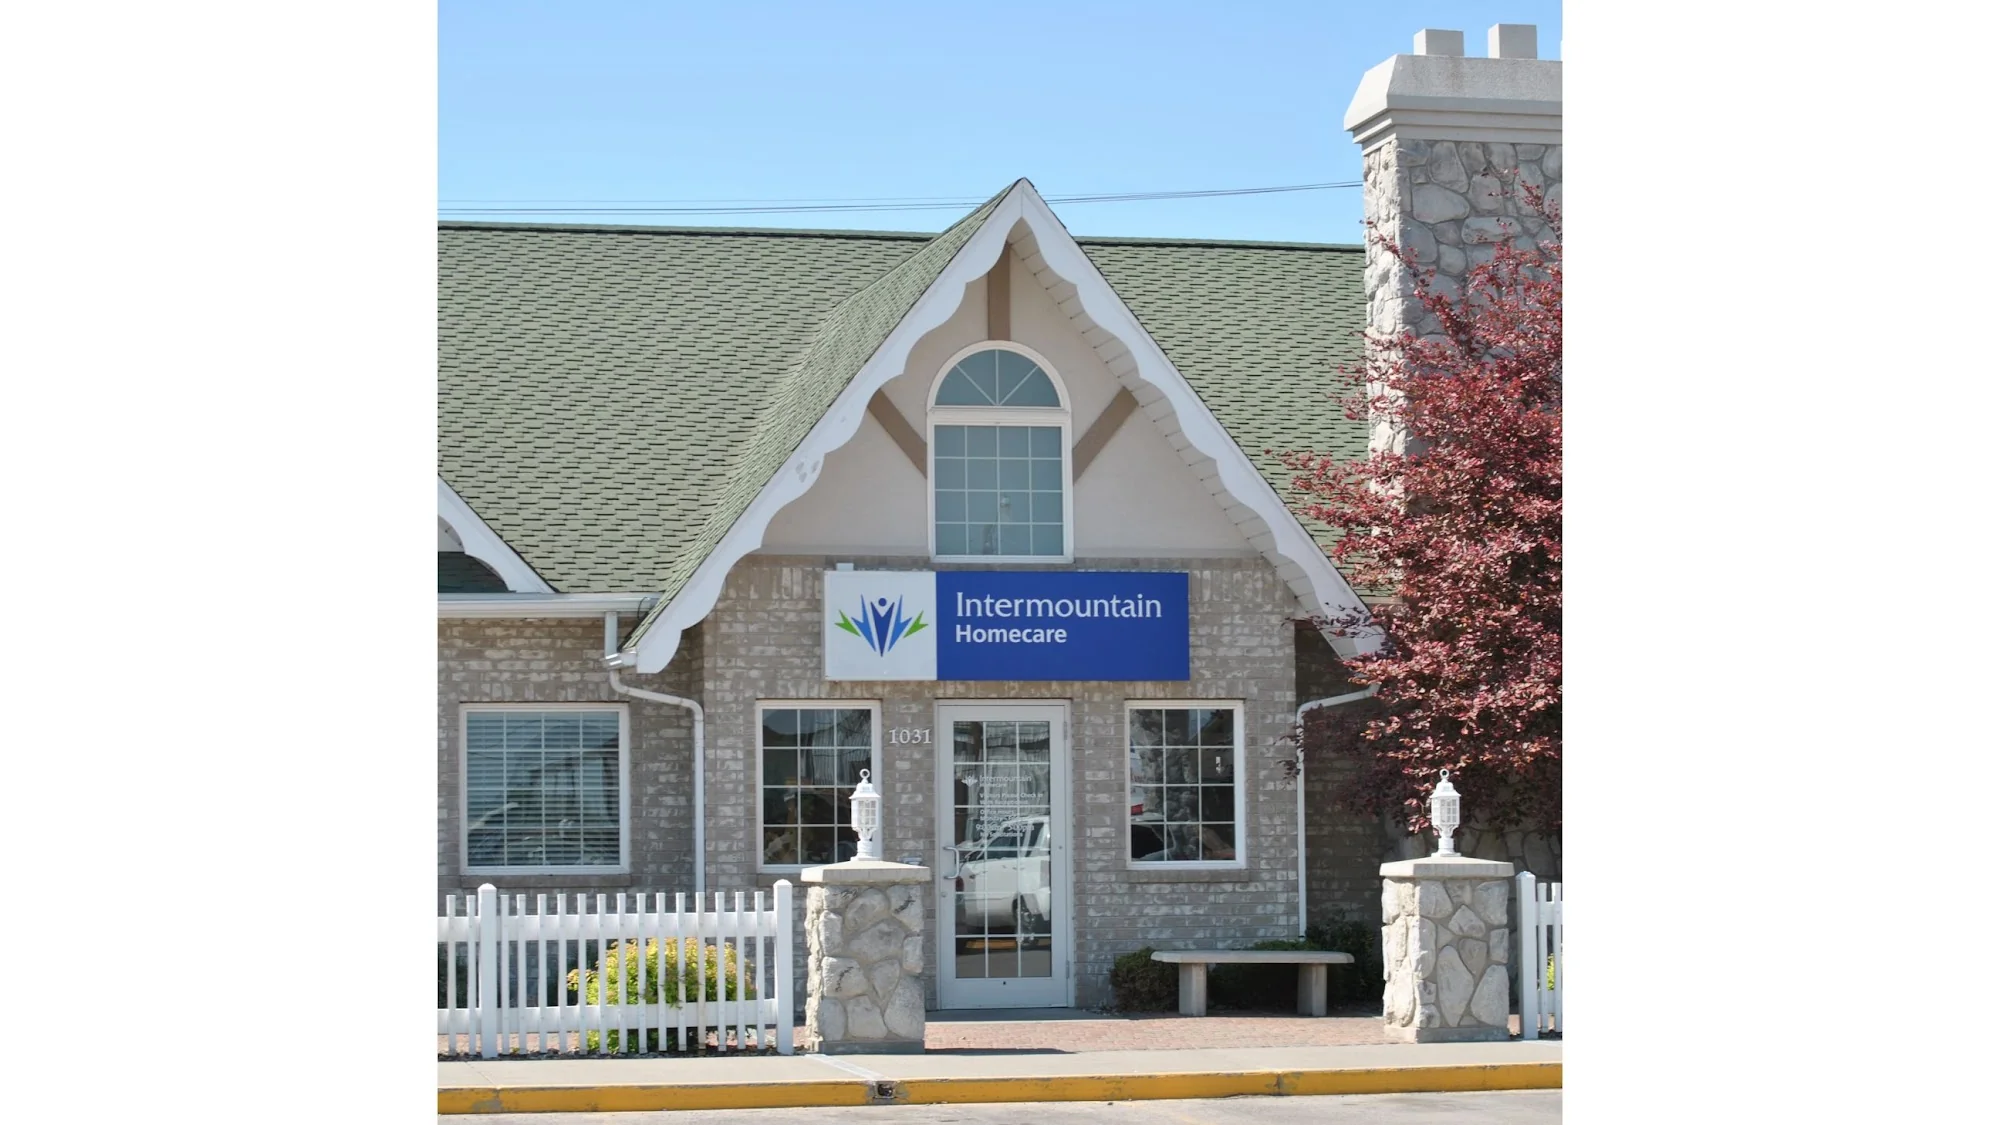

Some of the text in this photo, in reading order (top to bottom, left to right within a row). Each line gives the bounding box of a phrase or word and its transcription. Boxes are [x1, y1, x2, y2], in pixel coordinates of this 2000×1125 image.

[956, 591, 1162, 618] Intermountain
[956, 624, 1067, 643] Homecare
[888, 728, 933, 744] 1031
